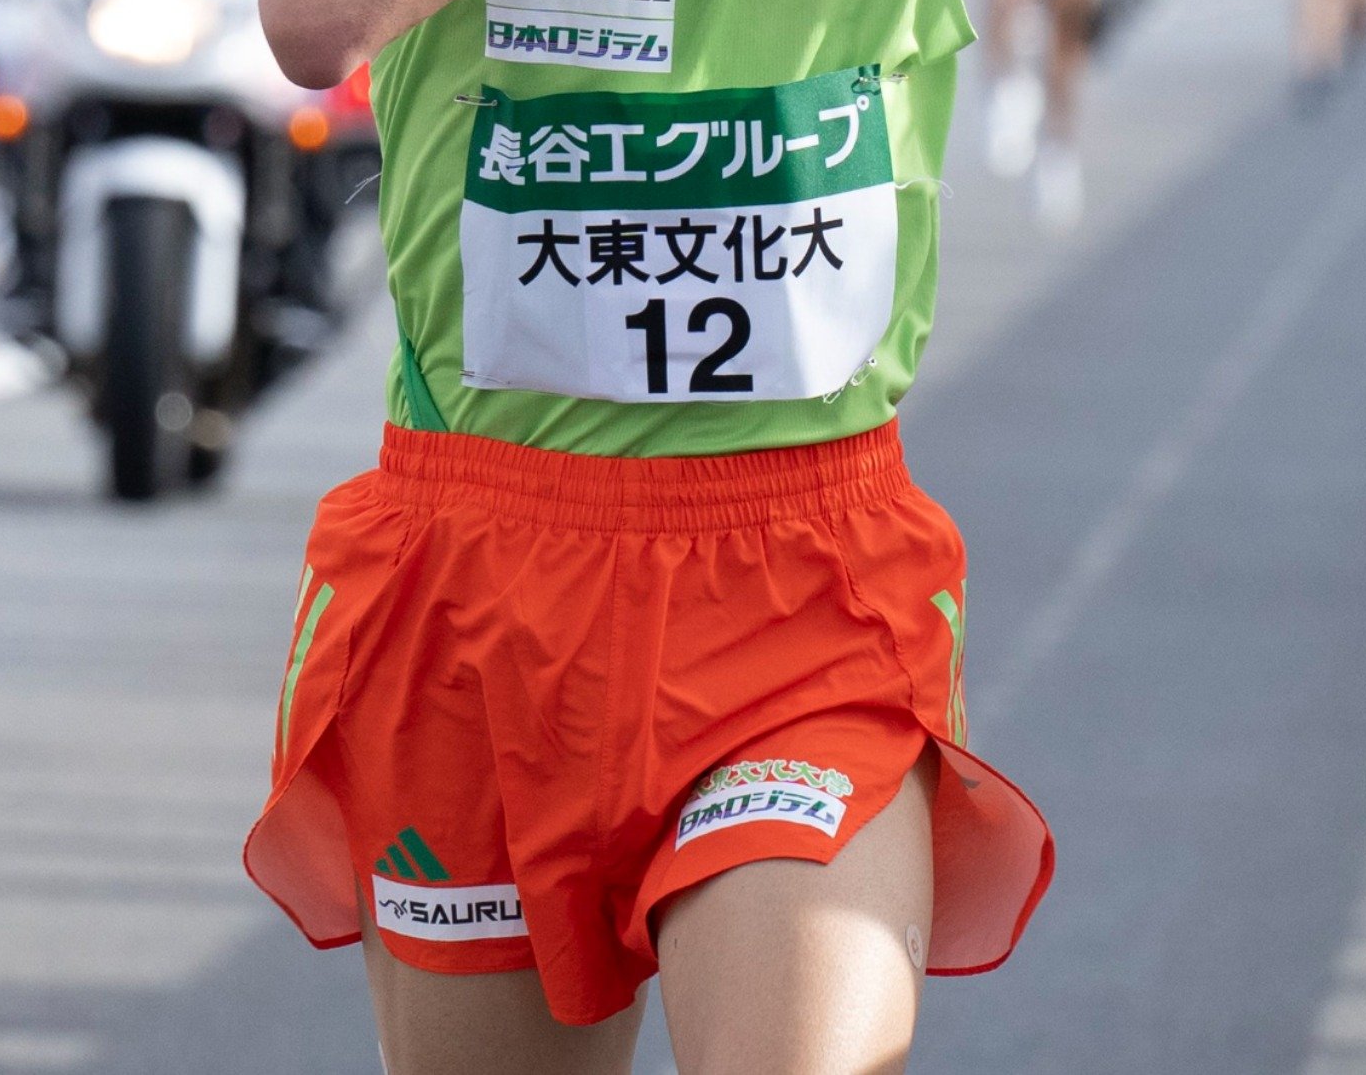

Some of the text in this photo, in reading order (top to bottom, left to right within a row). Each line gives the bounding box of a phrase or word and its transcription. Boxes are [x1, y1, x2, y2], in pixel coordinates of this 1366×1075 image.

[488, 19, 669, 62] 日本ロジテム
[478, 94, 870, 187] 長谷工グループ
[516, 207, 844, 287] 大東文化大
[624, 296, 754, 395] 12
[678, 790, 835, 840] 日本ロジテム
[409, 899, 523, 925] SAURU
